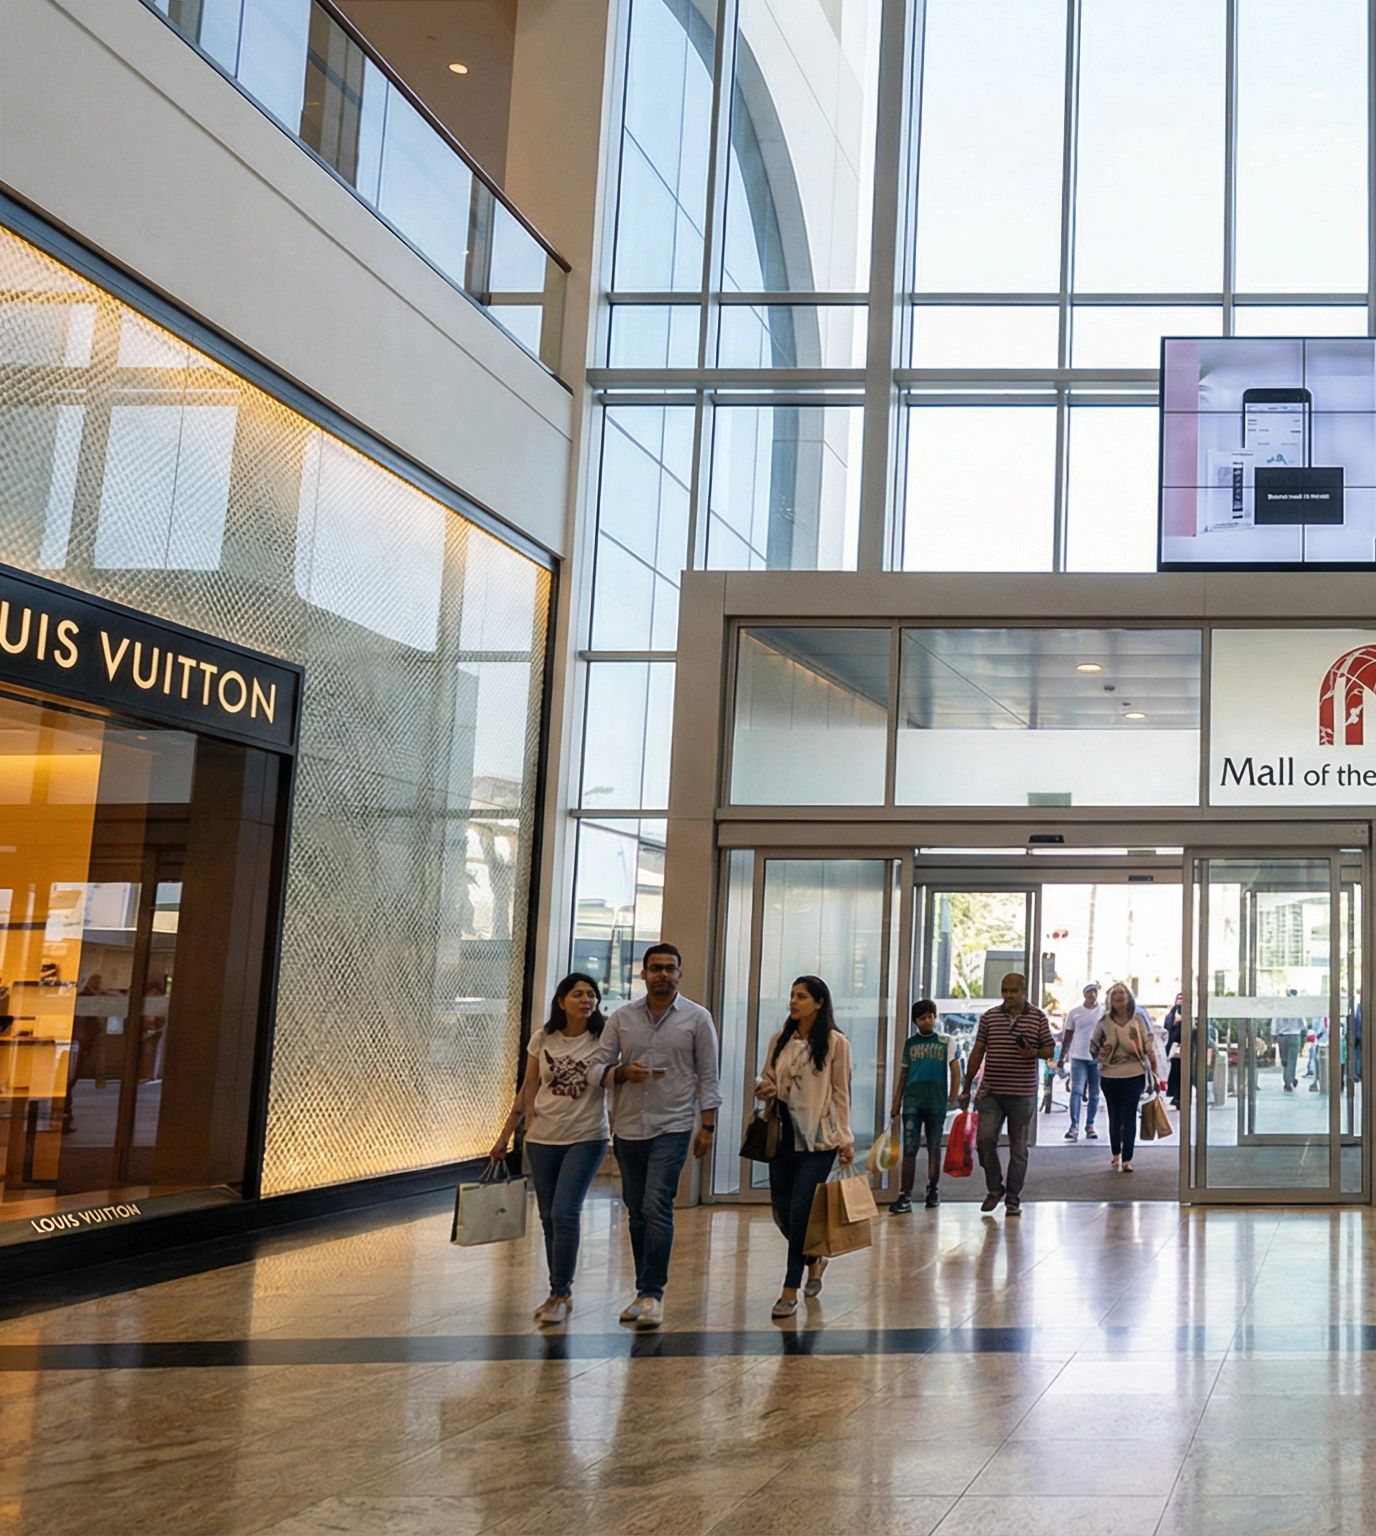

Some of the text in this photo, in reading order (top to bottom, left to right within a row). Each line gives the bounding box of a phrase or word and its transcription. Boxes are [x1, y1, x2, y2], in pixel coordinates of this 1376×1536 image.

[101, 631, 277, 724] VUITTON
[1220, 757, 1294, 786] Mall
[1303, 763, 1331, 786] of
[31, 1204, 142, 1233] LOUIS VUITTON
